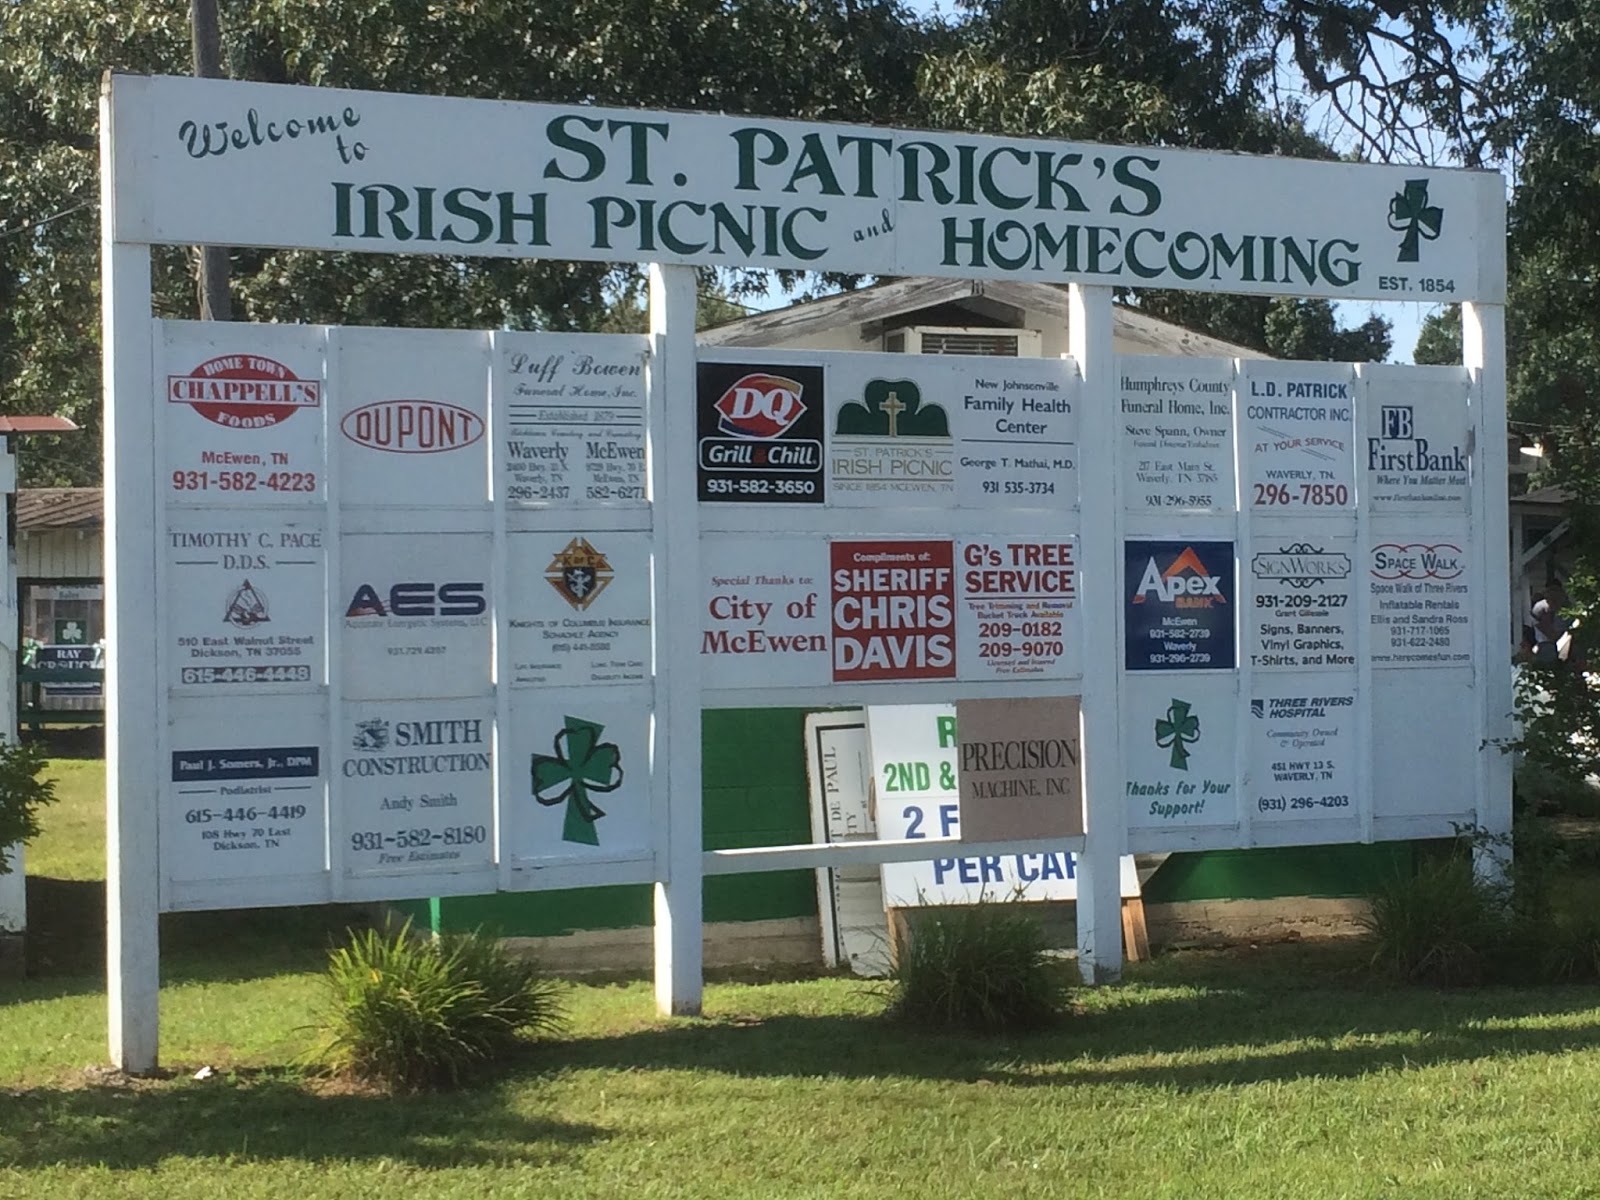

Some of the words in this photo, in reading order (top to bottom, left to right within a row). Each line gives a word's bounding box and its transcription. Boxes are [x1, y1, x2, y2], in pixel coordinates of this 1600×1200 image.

[179, 105, 361, 158] Welcome
[337, 134, 369, 163] to
[543, 114, 688, 187] ST.
[730, 127, 1162, 217] PATRICK'S
[332, 182, 551, 246] IRISH
[591, 196, 829, 259] PICNIC
[853, 207, 894, 243] and
[942, 217, 1361, 287] HOMECOMING
[1378, 277, 1412, 292] EST.
[1418, 278, 1456, 293] 1854
[203, 357, 243, 376] HOME
[248, 358, 286, 379] TOWN
[572, 355, 641, 375] Bowen
[173, 380, 316, 402] CHAPPELL'S
[975, 379, 998, 390] New
[1003, 380, 1060, 391] Johnsonville
[1120, 376, 1184, 395] Humphreys
[1189, 378, 1229, 396] County
[1251, 381, 1282, 397] L.D.
[1287, 383, 1348, 399] PATRICK
[730, 388, 793, 426] DQ
[964, 396, 1014, 415] Family
[1022, 398, 1071, 413] Health
[1121, 399, 1163, 414] Funeral
[1169, 400, 1205, 415] Home,
[1210, 400, 1230, 415] Inc.
[1248, 406, 1326, 421] CONTRACTOR
[217, 412, 275, 428] FOODS
[356, 405, 473, 448] DUPONT
[996, 419, 1048, 434] Center
[1382, 406, 1413, 439] FB
[507, 441, 568, 463] Waverly
[586, 441, 646, 459] McEwen
[709, 445, 752, 463] Grill
[1255, 443, 1269, 453] AT
[1273, 439, 1301, 450] YOUR
[1305, 437, 1345, 451] SERVICE
[202, 452, 266, 466] McEwen,
[271, 453, 289, 465] TN
[960, 458, 997, 470] George
[1053, 460, 1076, 470] M.D.
[1368, 438, 1466, 472] FirstBank
[832, 459, 882, 474] IRISH
[891, 460, 952, 475] PICNIC
[1266, 470, 1315, 481] WAVERLY,
[173, 471, 316, 492] 931-582-4223
[707, 479, 815, 494] 931-582-3650
[983, 481, 999, 493] 931
[1005, 481, 1055, 494] 535-3734
[1254, 484, 1348, 505] 296-7850
[170, 533, 250, 548] TIMOTHY
[280, 533, 321, 548] PACE
[223, 555, 271, 570] D.D.S.
[854, 553, 916, 564] Compliments
[964, 544, 1002, 566] G's
[1007, 544, 1074, 566] TREE
[712, 576, 750, 587] Special
[755, 576, 794, 586] Thanks
[834, 568, 950, 592] SHERIFF
[965, 570, 1075, 593] SERVICE
[1133, 556, 1224, 603] Apex
[346, 582, 487, 617] AES
[709, 595, 772, 625] City
[787, 592, 818, 618] of
[1256, 594, 1348, 608] 931-209-2127
[1425, 600, 1459, 609] Rentals
[834, 595, 951, 630] CHRIS
[1393, 614, 1410, 624] and
[979, 622, 1062, 638] 209-0182
[1260, 624, 1293, 635] Signs,
[1297, 624, 1344, 635] Banners,
[203, 637, 229, 646] East
[233, 636, 274, 645] Walnut
[279, 636, 314, 645] Street
[700, 631, 828, 654] McEwen
[979, 642, 1064, 657] 209-9070
[1163, 642, 1196, 652] Waverly
[1261, 639, 1289, 651] Vinyl
[1293, 639, 1344, 650] Graphics,
[57, 650, 81, 658] RAY
[835, 634, 952, 671] DAVIS
[1251, 655, 1298, 666] T-Shirts,
[1302, 655, 1322, 665] and
[1326, 654, 1355, 665] More
[1269, 698, 1308, 708] THREE
[1311, 697, 1353, 706] RIVERS
[1269, 708, 1325, 718] HOSPITAL
[395, 719, 483, 746] SMITH
[962, 739, 1078, 772] PRECISION
[343, 753, 492, 777] CONSTRUCTION
[824, 746, 839, 792] PAUL
[1289, 761, 1310, 770] HWY
[884, 762, 930, 792] 2ND
[939, 761, 957, 790] &
[1321, 771, 1333, 780] TN
[1126, 781, 1170, 796] Thanks
[1176, 780, 1196, 795] for
[1202, 780, 1231, 794] Your
[380, 796, 414, 812] Andy
[419, 793, 458, 808] Smith
[1149, 799, 1205, 819] Support!
[1258, 796, 1286, 813] (931)
[1290, 795, 1349, 809] 296-4203
[185, 805, 306, 823] 615-446-4419
[903, 806, 925, 839] 2
[224, 830, 246, 840] Hwy
[252, 828, 264, 837] 70
[269, 828, 291, 836] East
[352, 825, 487, 851] 931-582-8180
[265, 839, 279, 848] TN
[934, 856, 1004, 885] PER
